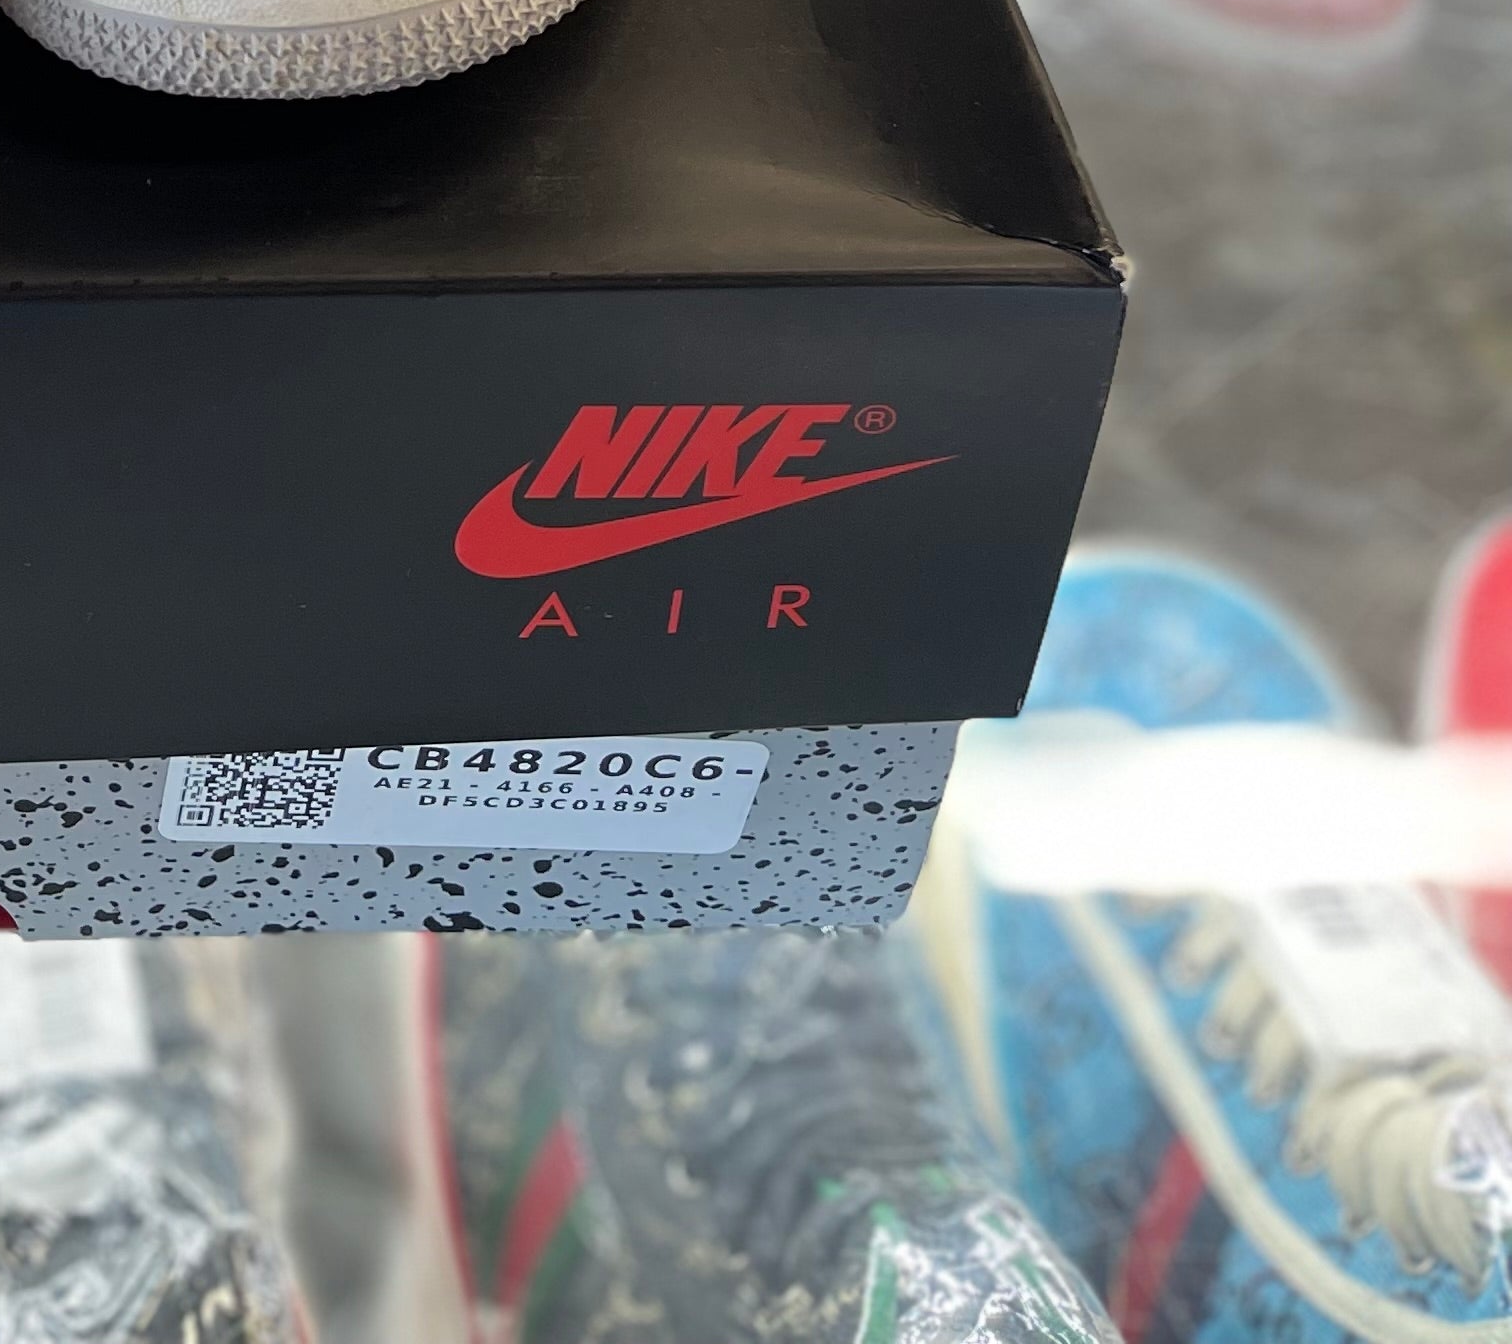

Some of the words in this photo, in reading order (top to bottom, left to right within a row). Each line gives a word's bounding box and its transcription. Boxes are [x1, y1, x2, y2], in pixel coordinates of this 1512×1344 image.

[518, 584, 811, 639] AIR
[366, 744, 754, 782] CB4820C6-
[373, 777, 453, 791] AE21
[495, 780, 574, 796] 4166
[614, 783, 697, 799] A408
[418, 794, 670, 814] DF5CD3C01895
